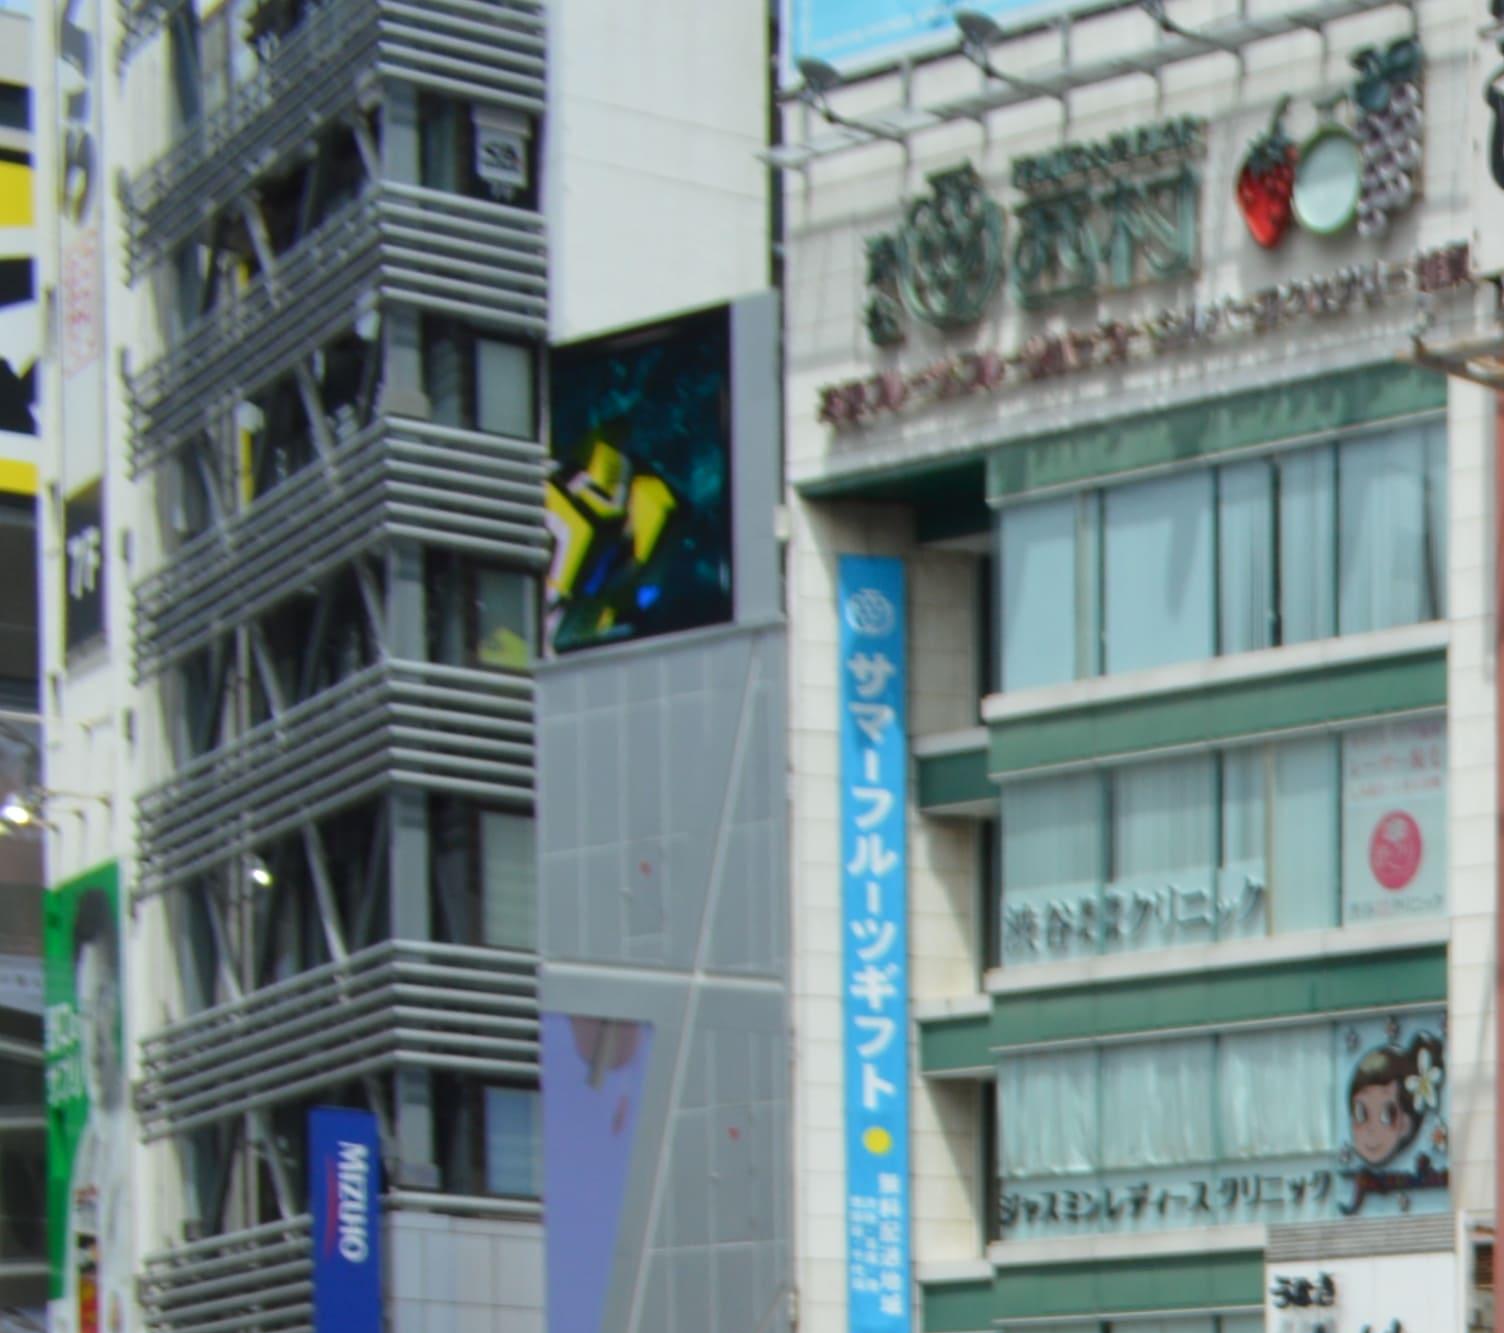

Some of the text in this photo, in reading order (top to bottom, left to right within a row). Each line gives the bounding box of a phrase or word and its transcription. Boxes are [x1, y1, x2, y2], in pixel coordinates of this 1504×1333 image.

[847, 652, 900, 1110] サマーフルーツギフト
[336, 1140, 369, 1264] MIZUHO
